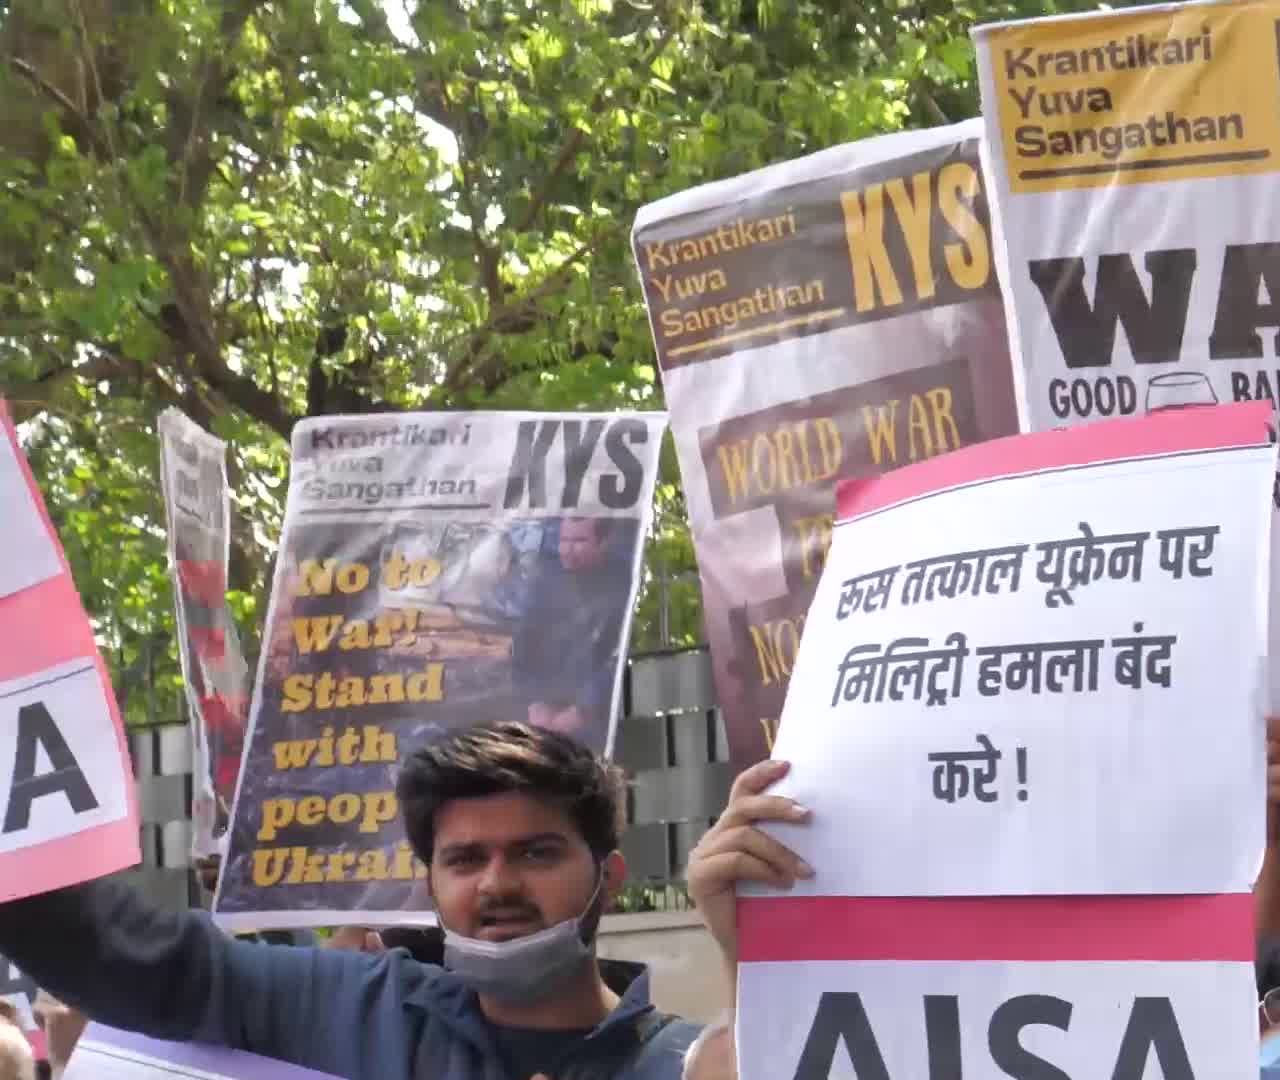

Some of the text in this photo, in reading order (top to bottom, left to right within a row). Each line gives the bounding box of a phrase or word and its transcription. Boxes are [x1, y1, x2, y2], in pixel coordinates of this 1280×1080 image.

[1004, 33, 1213, 80] Krantikari
[1008, 86, 1113, 119] Yuva
[1015, 111, 1244, 160] Sangathan
[646, 162, 990, 313] Krantikari KYS
[653, 266, 728, 303] Yuva
[660, 278, 825, 338] Sangathan
[1049, 375, 1137, 418] GOOD
[503, 419, 648, 511] KYS
[717, 386, 961, 504] WORLD WAR
[299, 554, 442, 596] No to
[901, 543, 1028, 606] तत्काल
[1036, 521, 1148, 608] यूक्रेन
[1156, 525, 1220, 580] पर
[976, 638, 1103, 696] हमला
[1111, 622, 1177, 690] बंद
[280, 663, 444, 713] Stand
[273, 725, 397, 770] with
[927, 733, 1002, 802] करे
